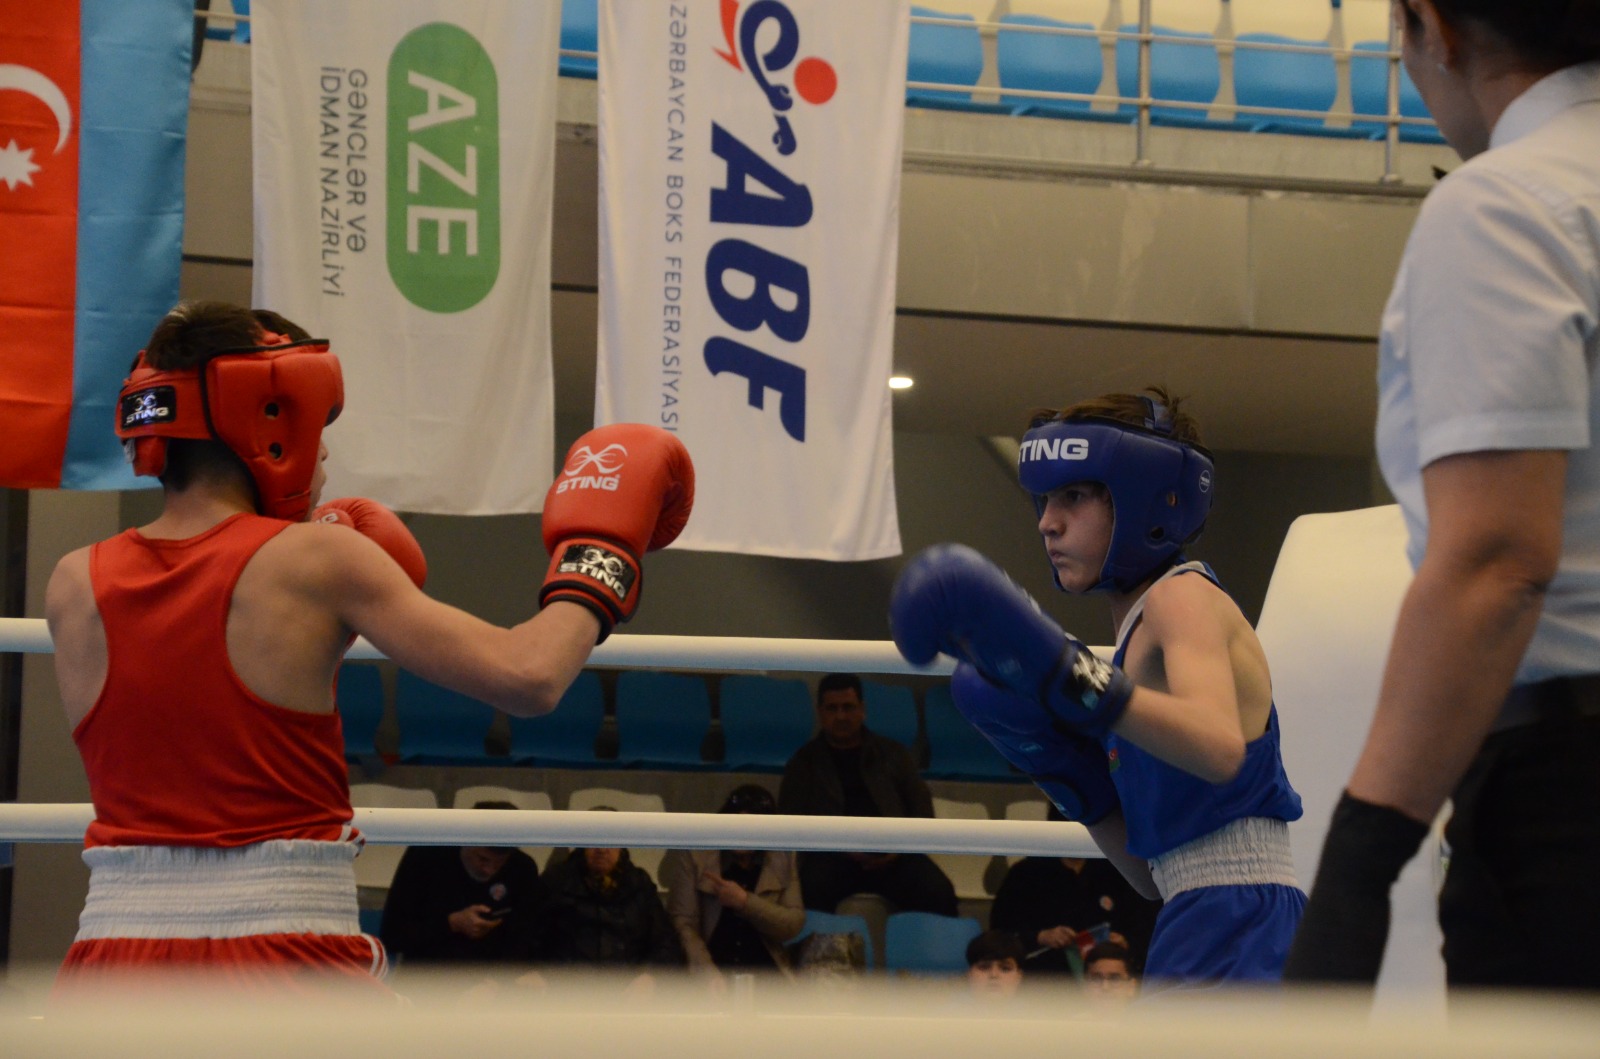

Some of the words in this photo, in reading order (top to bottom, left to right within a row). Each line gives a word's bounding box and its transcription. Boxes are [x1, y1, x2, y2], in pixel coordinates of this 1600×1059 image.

[319, 66, 346, 159] İDMAN
[346, 68, 368, 206] GƏNCLƏR
[667, 0, 687, 162] ZƏRBAYCAN
[406, 69, 478, 256] AZE
[665, 174, 684, 243] BOKS
[320, 166, 345, 297] NAZİRLİYİ
[346, 215, 367, 253] VƏ
[703, 119, 814, 443] ABF
[661, 256, 682, 432] FEDERASİYASI
[126, 406, 170, 425] STING
[555, 474, 620, 495] STING
[559, 561, 627, 600] STING
